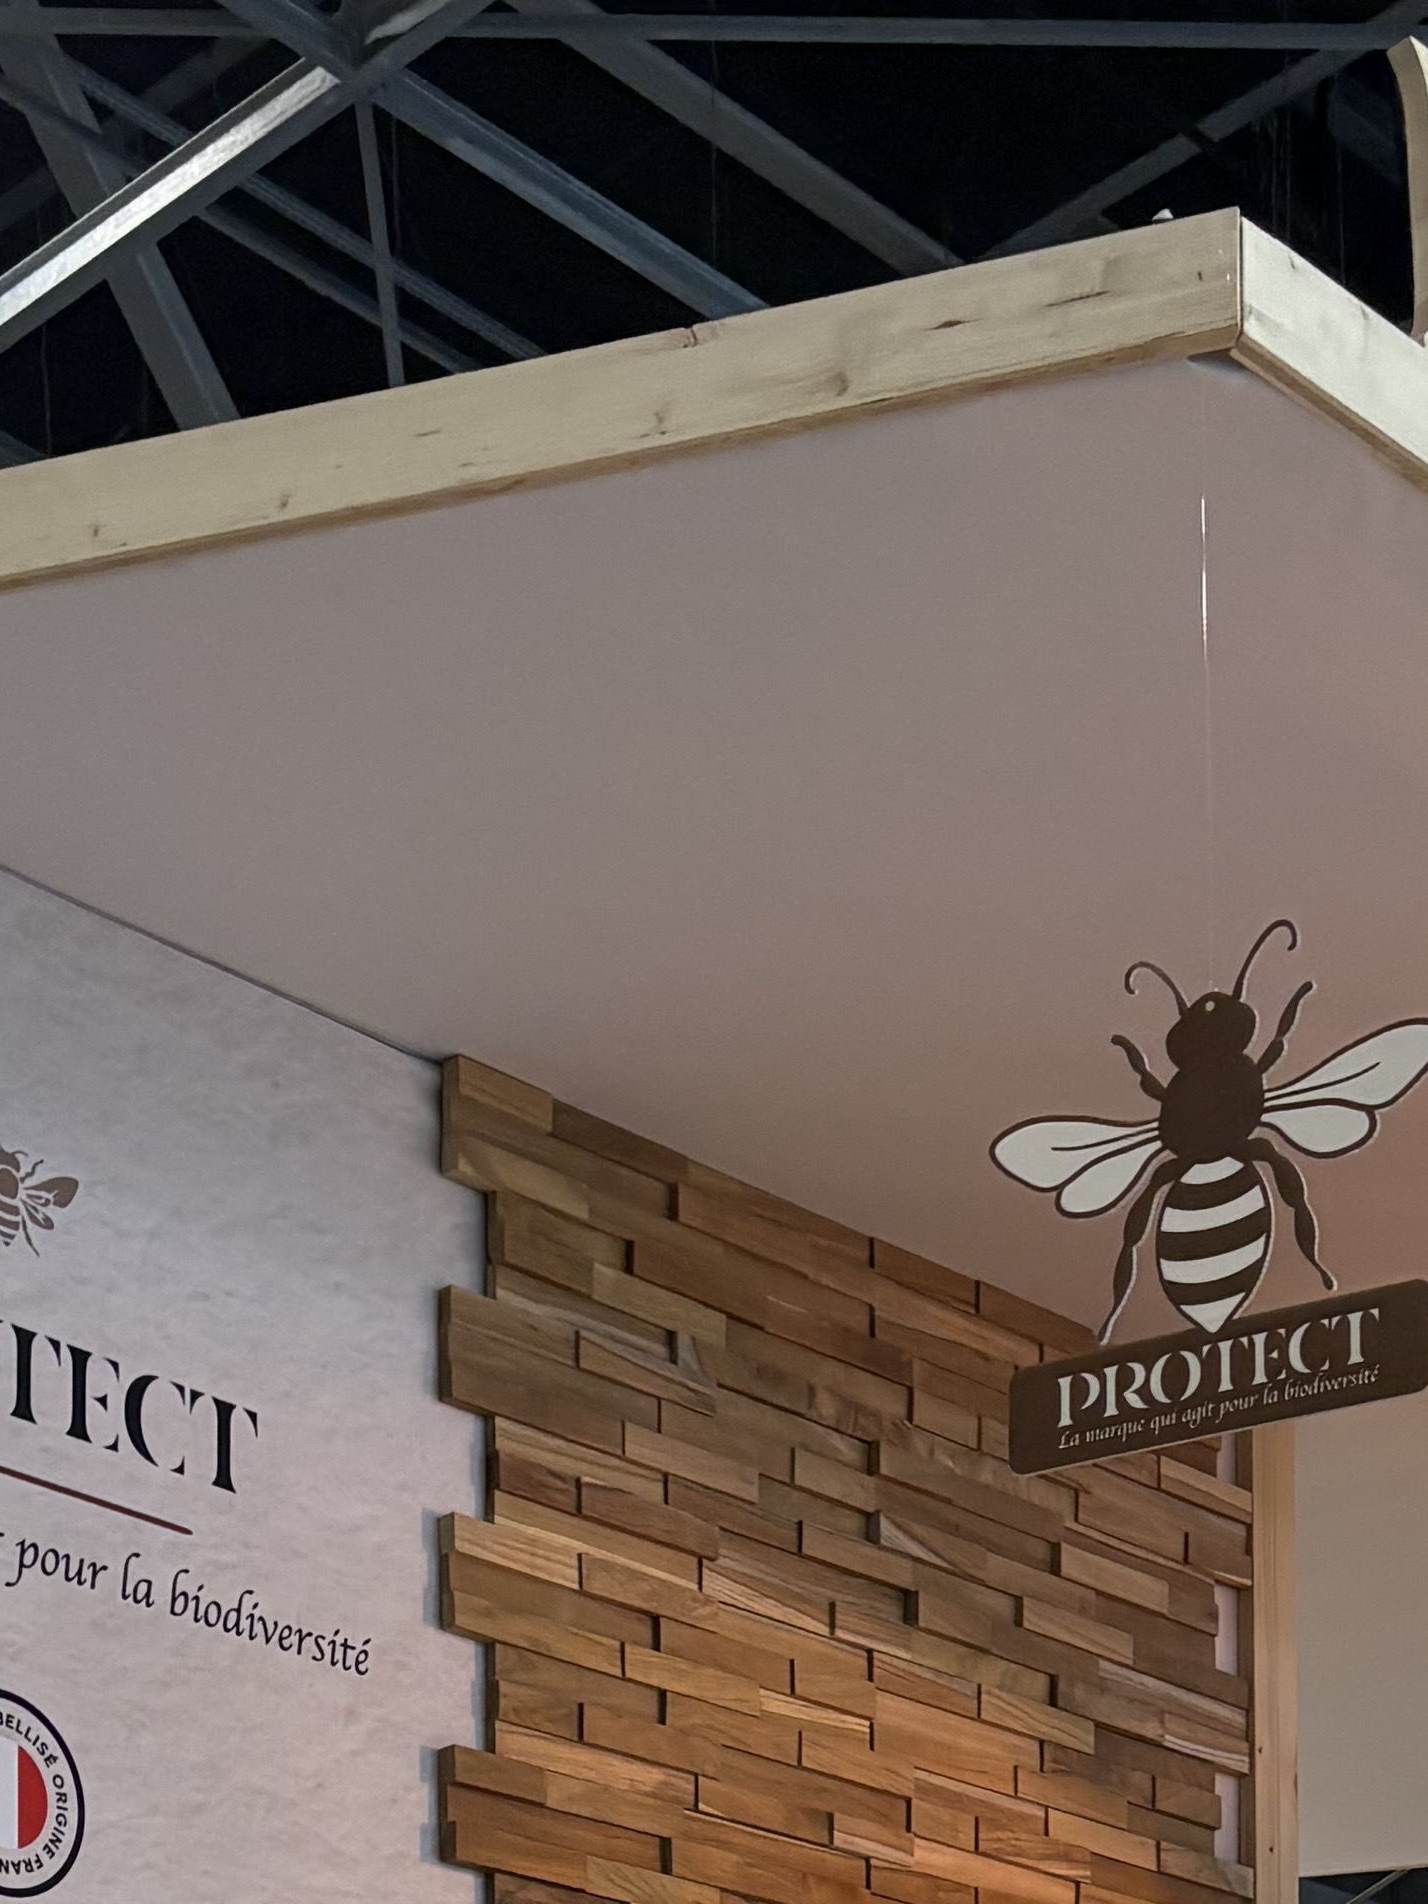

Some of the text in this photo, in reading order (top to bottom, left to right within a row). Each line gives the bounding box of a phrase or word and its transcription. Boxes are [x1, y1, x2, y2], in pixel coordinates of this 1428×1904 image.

[1057, 1308, 1379, 1427] PROTECT
[1058, 1364, 1380, 1449] La marque qui agit pour la biodiversité
[4, 1536, 108, 1588] pour
[120, 1553, 155, 1608] la
[169, 1568, 372, 1676] biodiversité
[42, 1774, 69, 1860] ORIGINE
